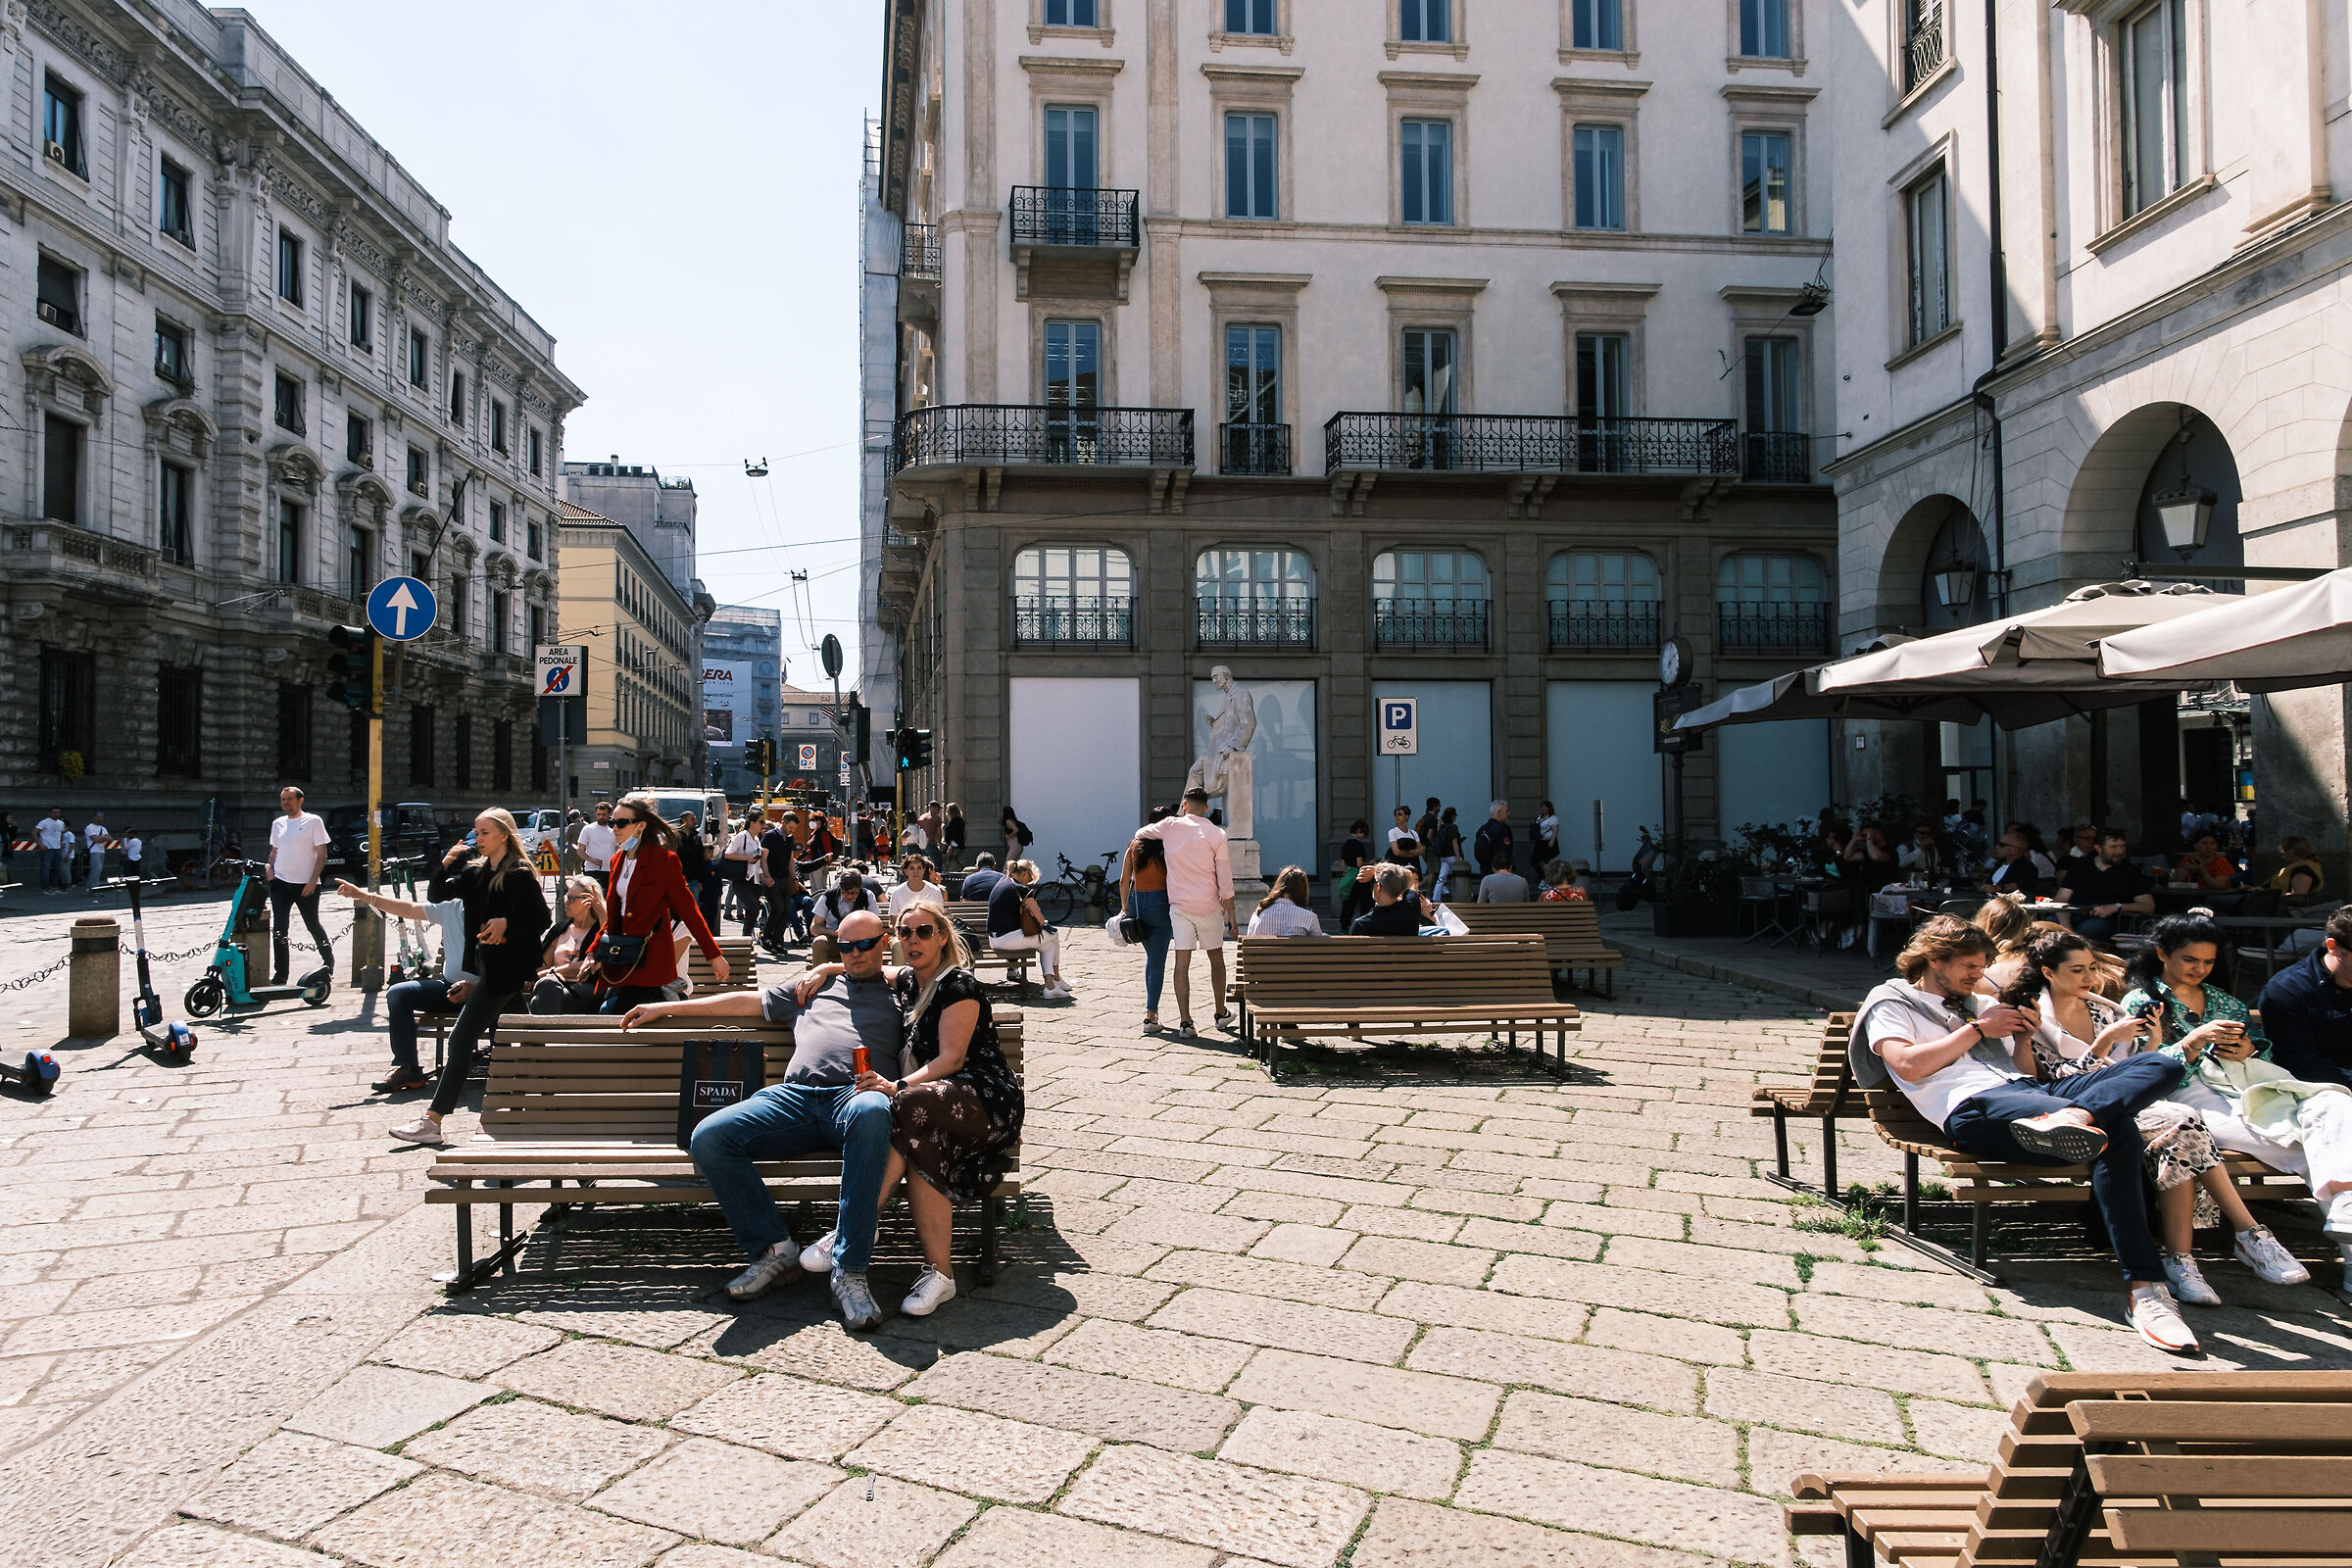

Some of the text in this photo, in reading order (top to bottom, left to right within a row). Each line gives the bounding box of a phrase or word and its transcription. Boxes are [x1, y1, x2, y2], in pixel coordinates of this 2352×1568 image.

[703, 668, 733, 681] ERA
[1392, 707, 1407, 726] P
[699, 1086, 736, 1097] SPADA
